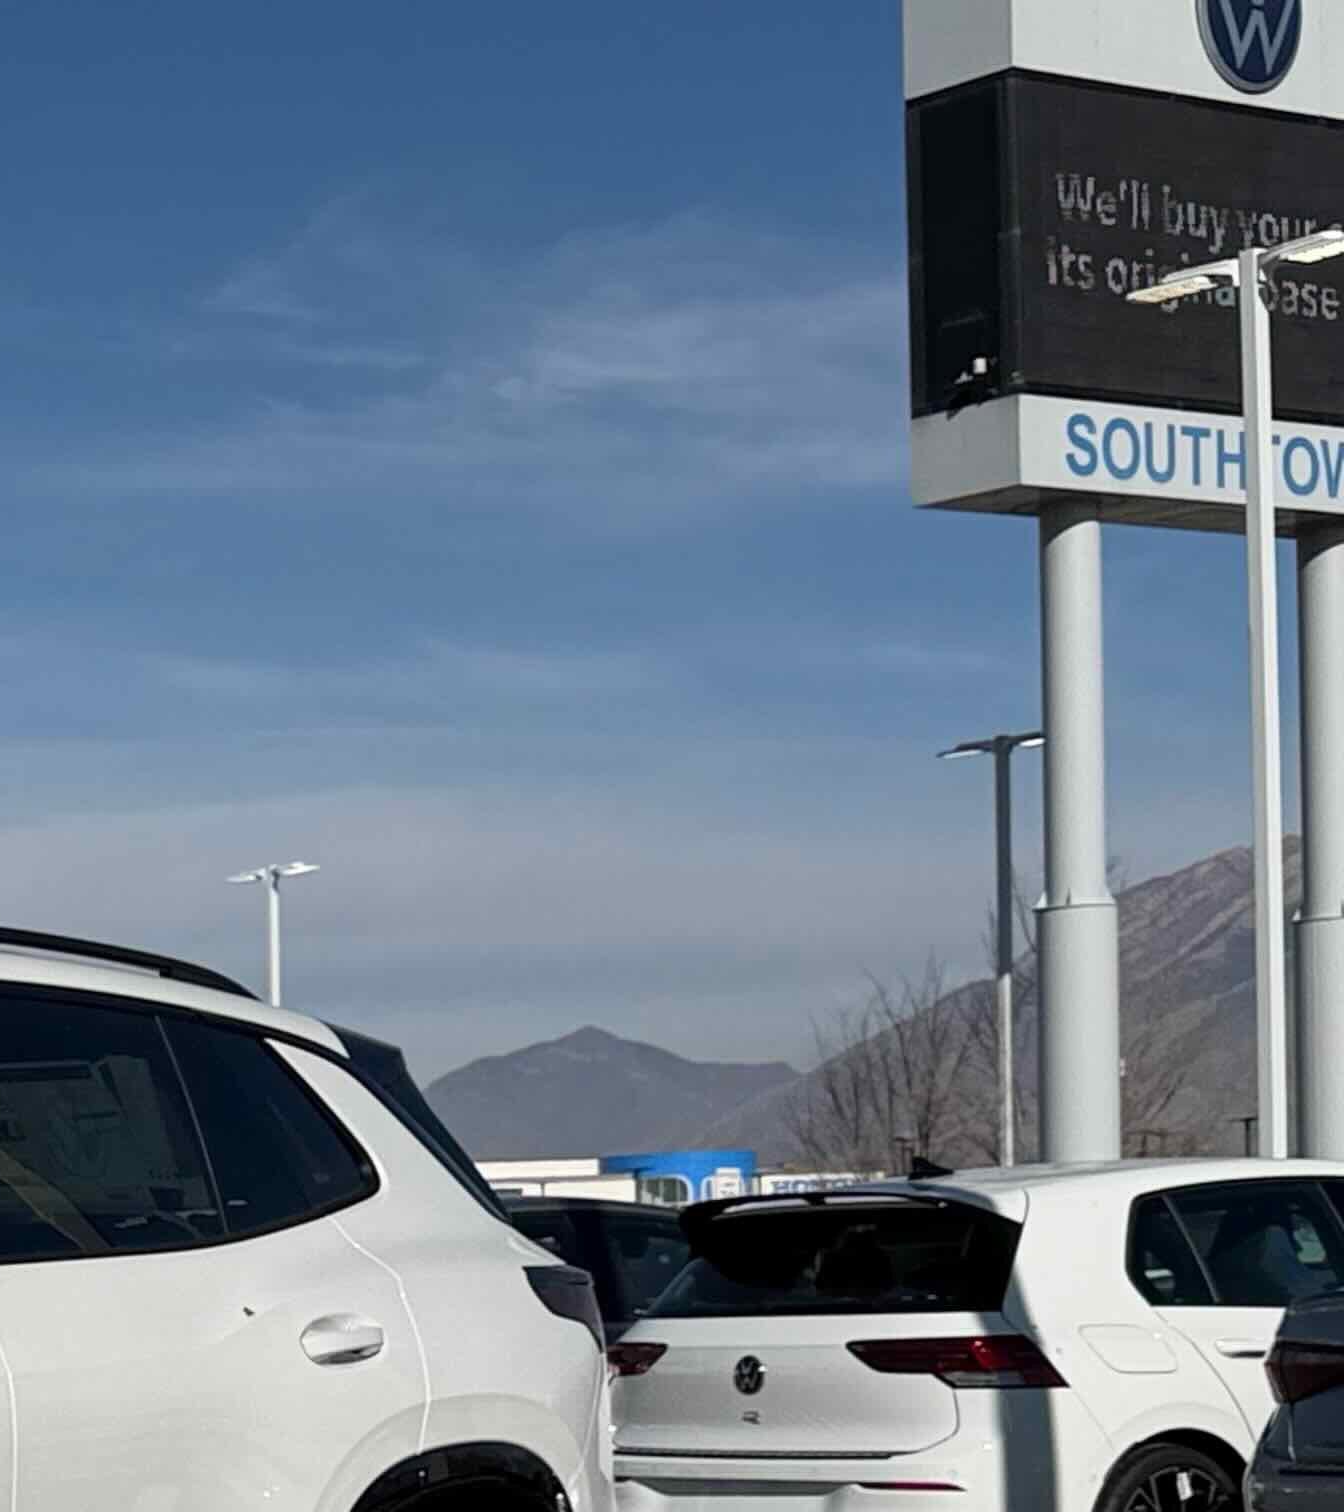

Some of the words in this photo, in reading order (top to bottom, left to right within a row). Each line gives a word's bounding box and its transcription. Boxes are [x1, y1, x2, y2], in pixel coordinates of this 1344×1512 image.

[1055, 173, 1150, 230] We'll
[1162, 184, 1228, 254] buy
[1236, 209, 1316, 249] your
[1046, 235, 1095, 289] its
[1064, 412, 1344, 498] SOUTHOW
